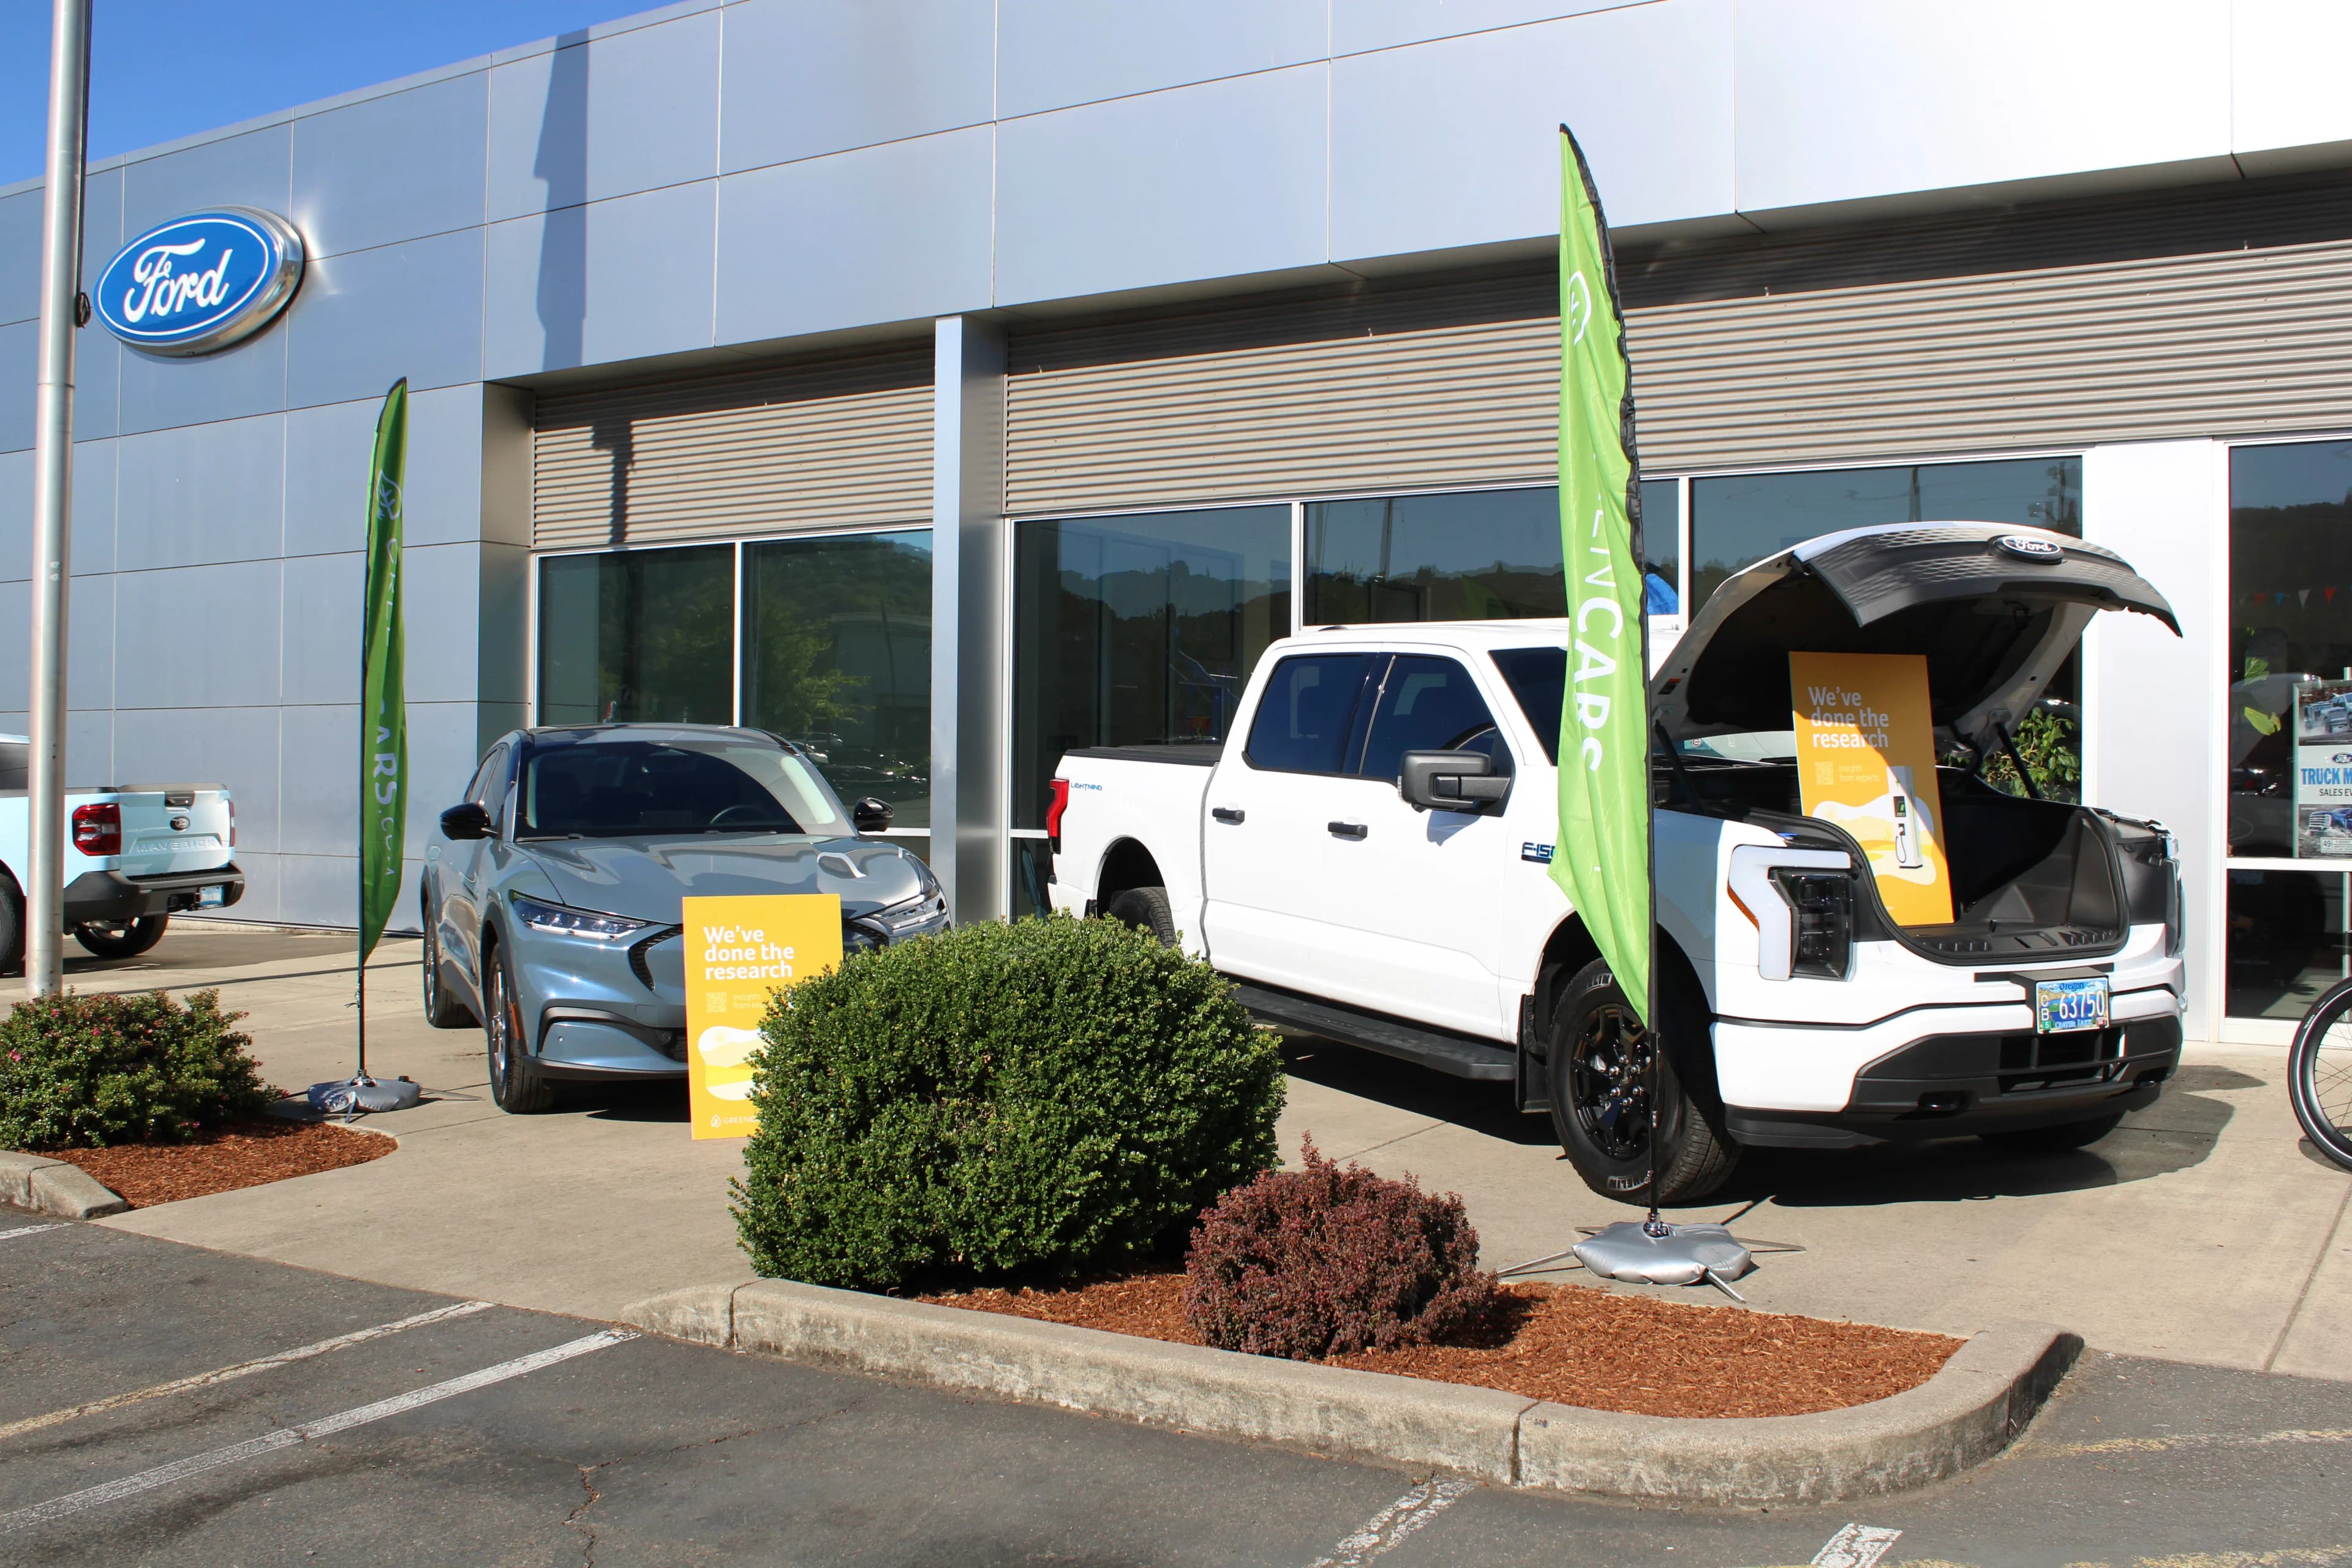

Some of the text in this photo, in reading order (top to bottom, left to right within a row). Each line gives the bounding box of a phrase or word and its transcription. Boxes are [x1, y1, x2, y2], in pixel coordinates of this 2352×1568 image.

[124, 238, 233, 323] Ford
[2013, 538, 2052, 551] Ford
[1808, 687, 1861, 706] We've
[1811, 707, 1890, 727] done the
[1812, 728, 1889, 748] research
[1839, 774, 1855, 782] from
[2301, 767, 2341, 785] TRUCK
[1070, 783, 1102, 791] LIGHTNING
[137, 839, 217, 852] MAVERICK
[703, 925, 764, 944] We've
[704, 942, 794, 962] done the
[705, 960, 793, 981] research
[2059, 982, 2085, 992] Oregon
[2059, 990, 2105, 1020] 63750
[2055, 1020, 2076, 1028] CRATER
